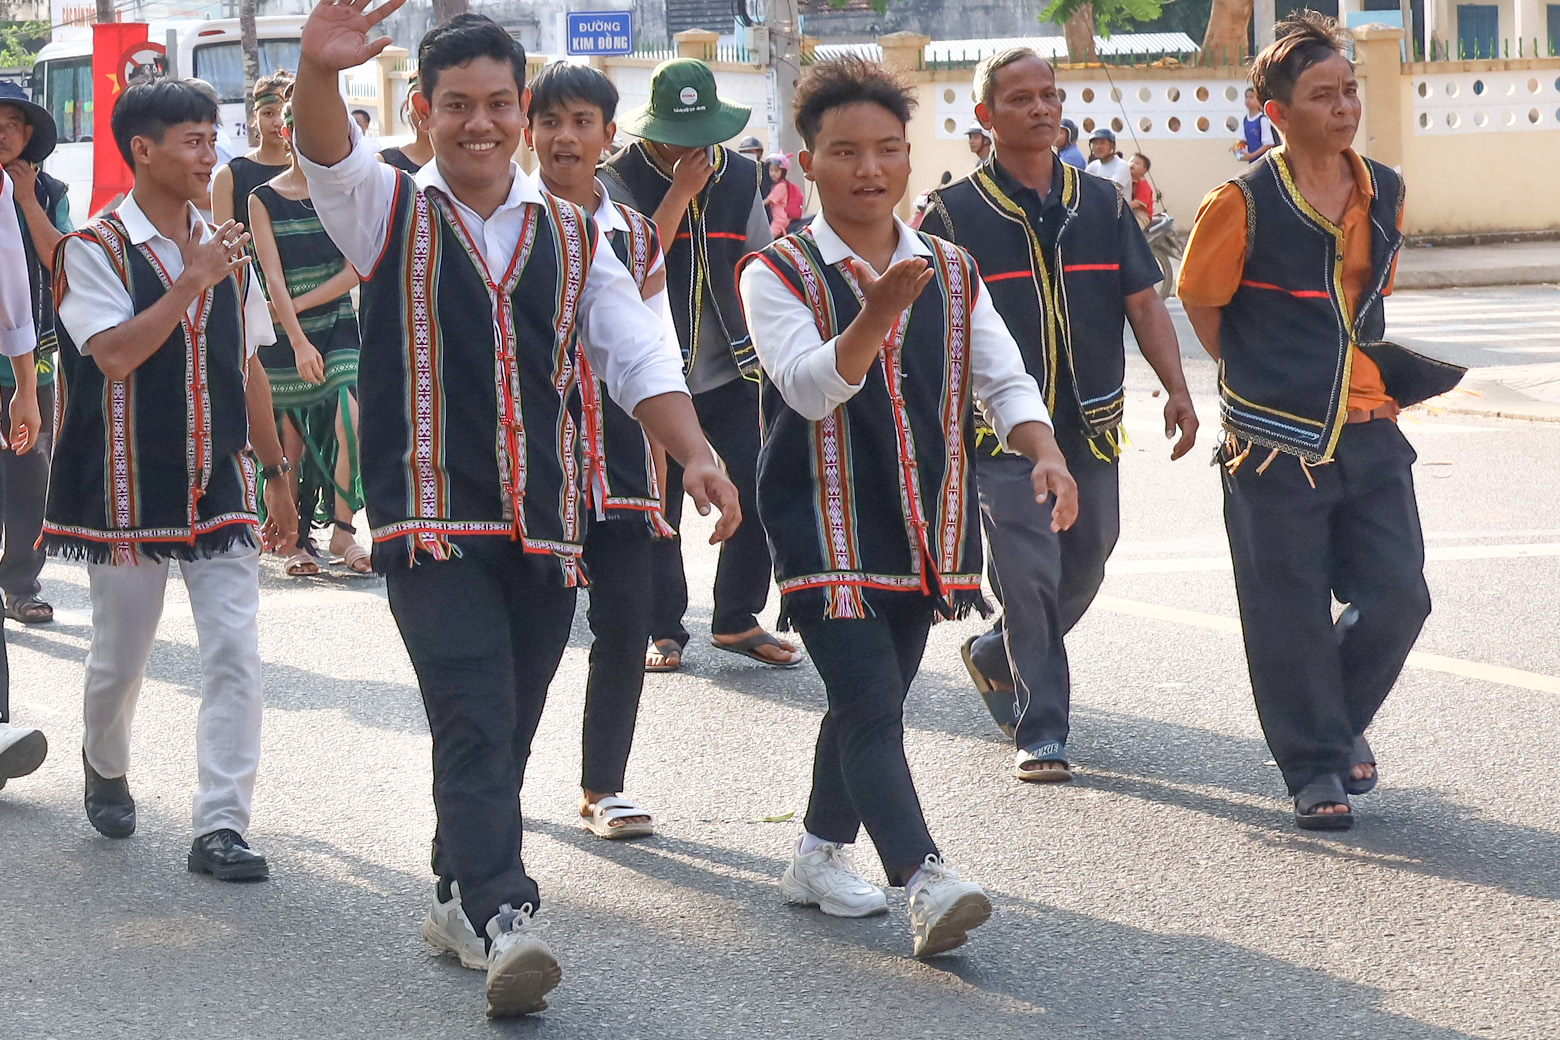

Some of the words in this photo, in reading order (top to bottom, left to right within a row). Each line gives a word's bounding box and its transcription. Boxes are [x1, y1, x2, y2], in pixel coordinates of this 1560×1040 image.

[579, 20, 621, 32] ĐƯỜNG
[572, 37, 594, 50] KIM
[598, 32, 628, 50] ĐỒNG
